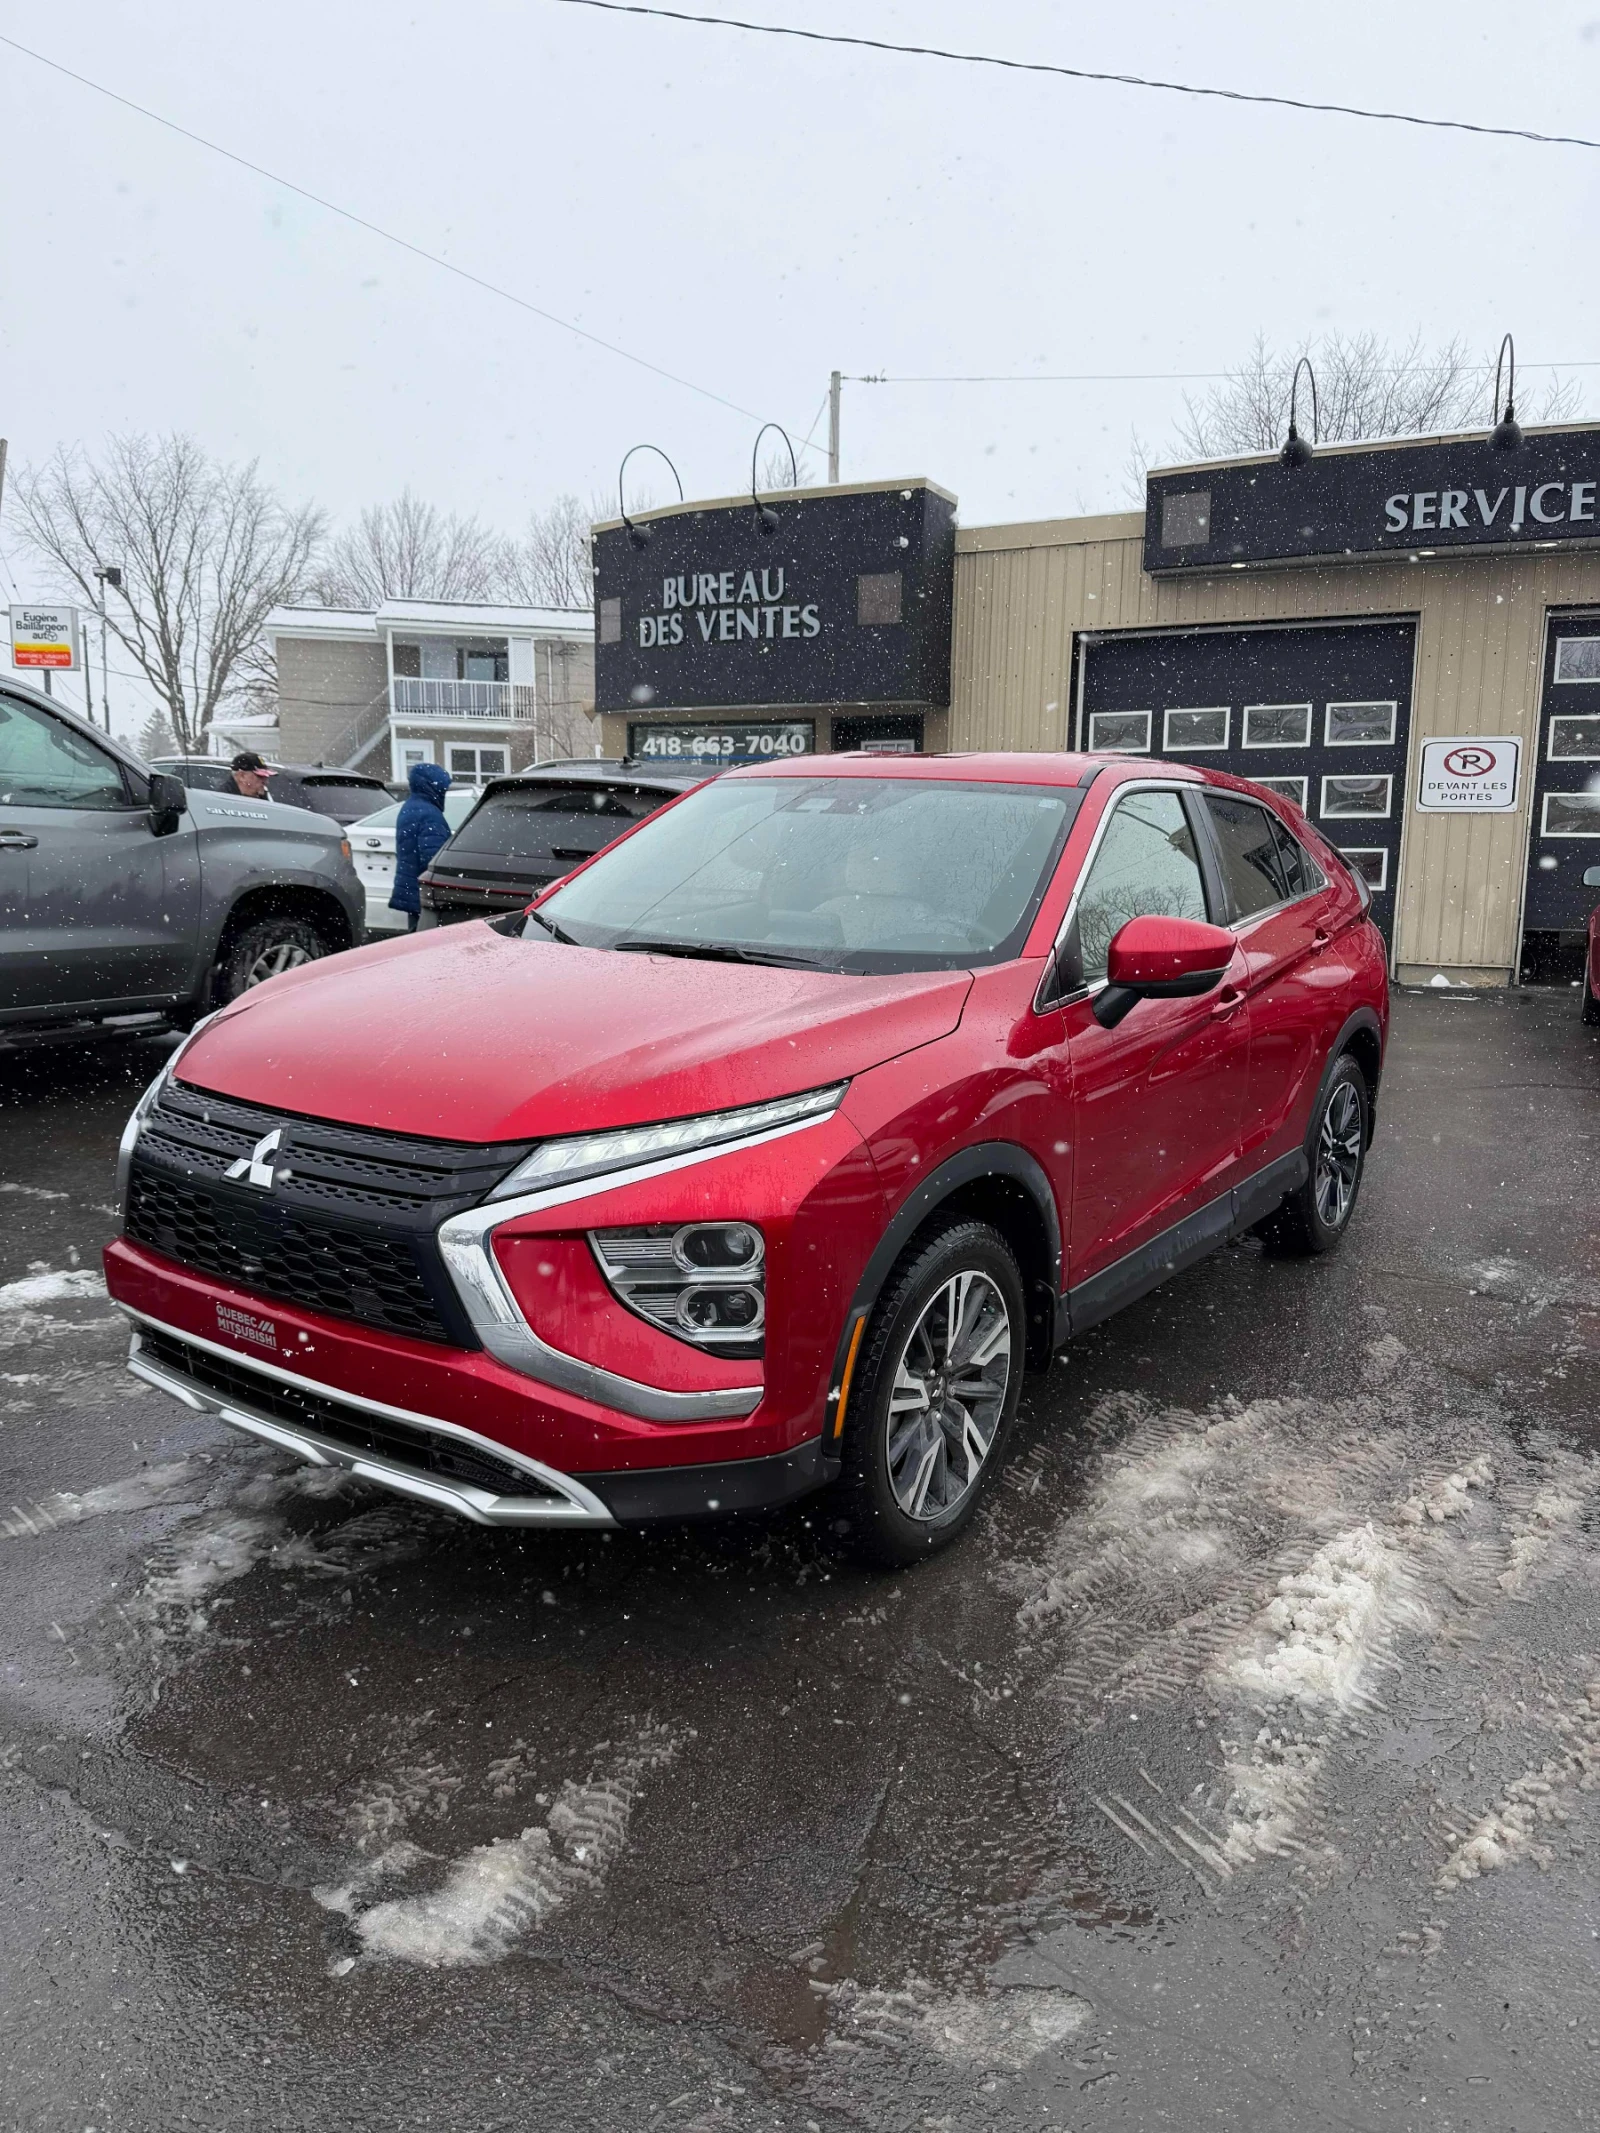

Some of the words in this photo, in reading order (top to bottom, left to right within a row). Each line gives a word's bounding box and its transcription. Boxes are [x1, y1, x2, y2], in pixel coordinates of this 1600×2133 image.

[1384, 481, 1597, 533] SERVICE
[663, 567, 785, 609] BUREAU
[15, 620, 68, 633] Baillargeon
[23, 611, 58, 624] Eugène
[639, 613, 684, 648] DES
[696, 604, 821, 642] VENTES
[642, 733, 806, 756] 418-663-7040
[1428, 782, 1478, 790] DEVANT
[1483, 782, 1508, 790] LES
[1440, 792, 1493, 801] PORTES
[216, 1304, 258, 1328] QUEBEC
[217, 1316, 277, 1348] MITSUBISHI
